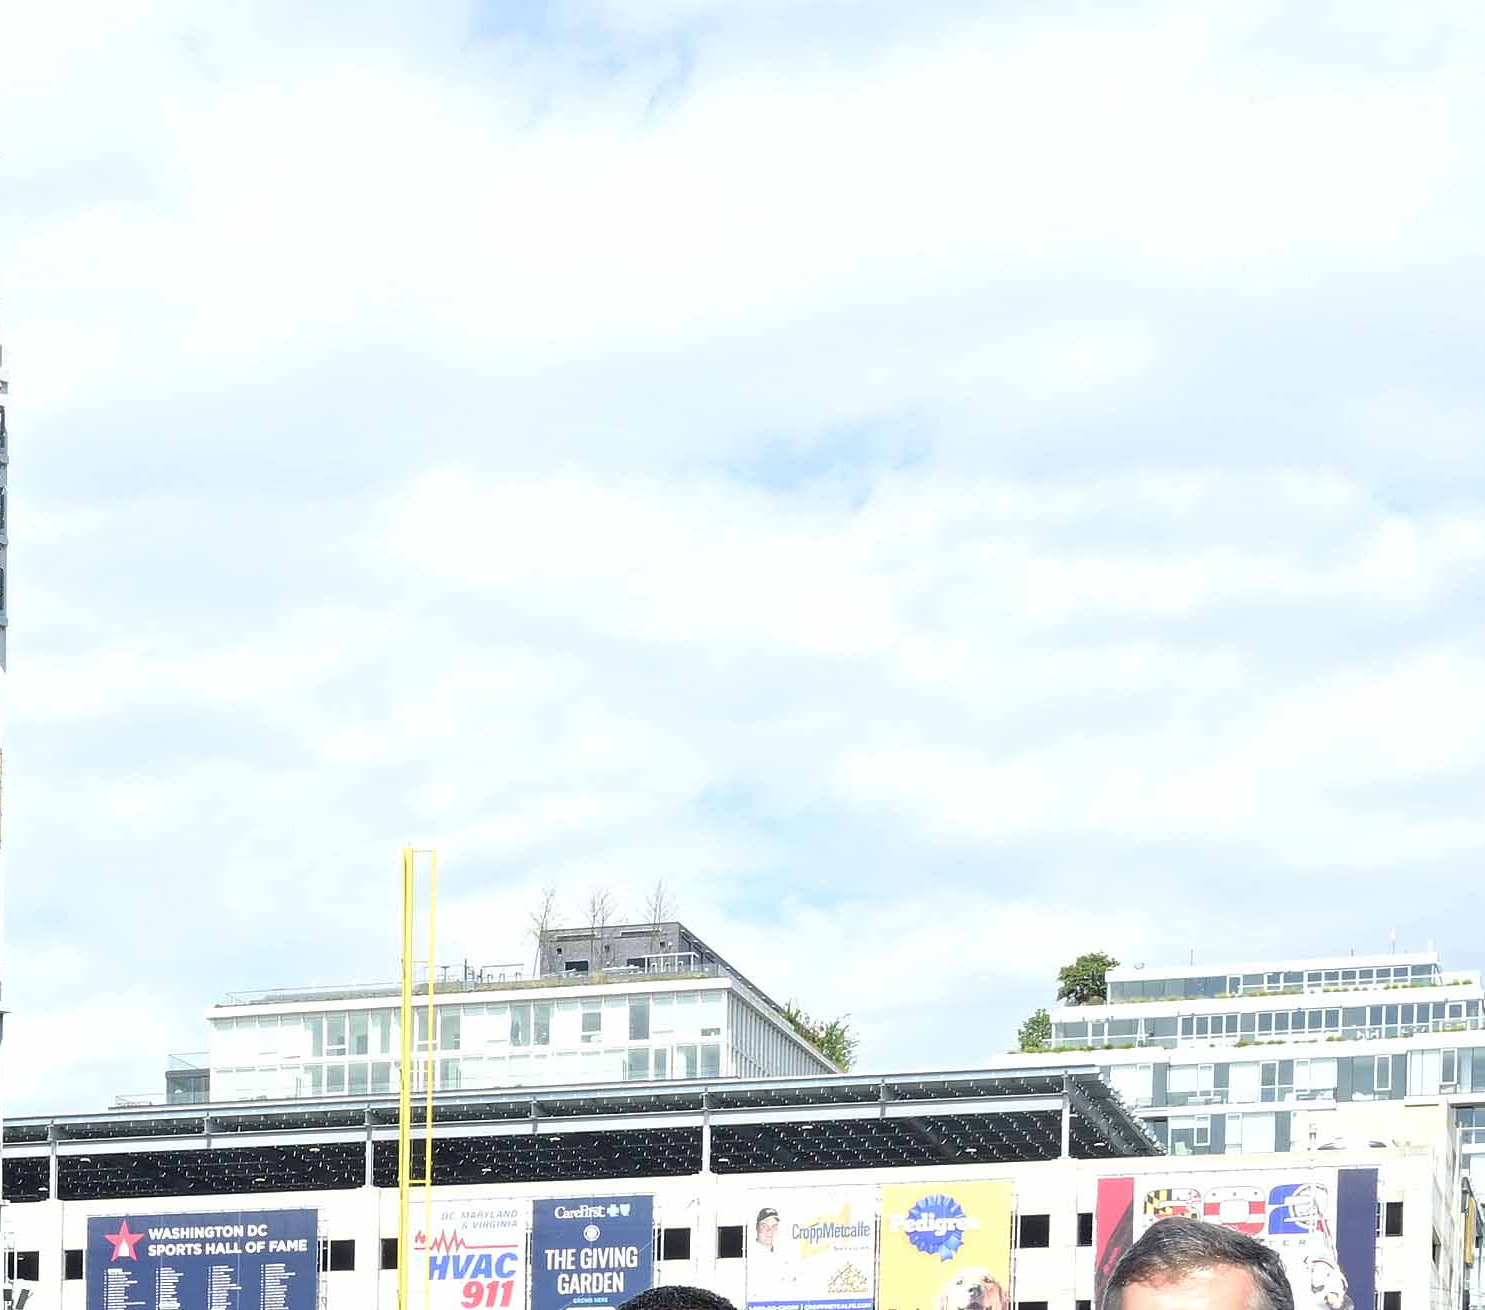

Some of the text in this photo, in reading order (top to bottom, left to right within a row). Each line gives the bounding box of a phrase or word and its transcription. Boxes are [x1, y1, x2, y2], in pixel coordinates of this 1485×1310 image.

[461, 1210, 518, 1220] MARYLAND
[554, 1204, 606, 1219] CareFirst
[148, 1224, 268, 1240] WASHINGTON DC
[473, 1220, 518, 1229] VIRGINIA
[792, 1222, 870, 1244] CroppMetcalfe
[148, 1239, 308, 1257] SPORTS HALL OF FAME
[428, 1252, 518, 1280] HVAC
[544, 1247, 638, 1271] THE GIVING
[557, 1272, 625, 1295] GARDEN
[461, 1281, 515, 1309] 911
